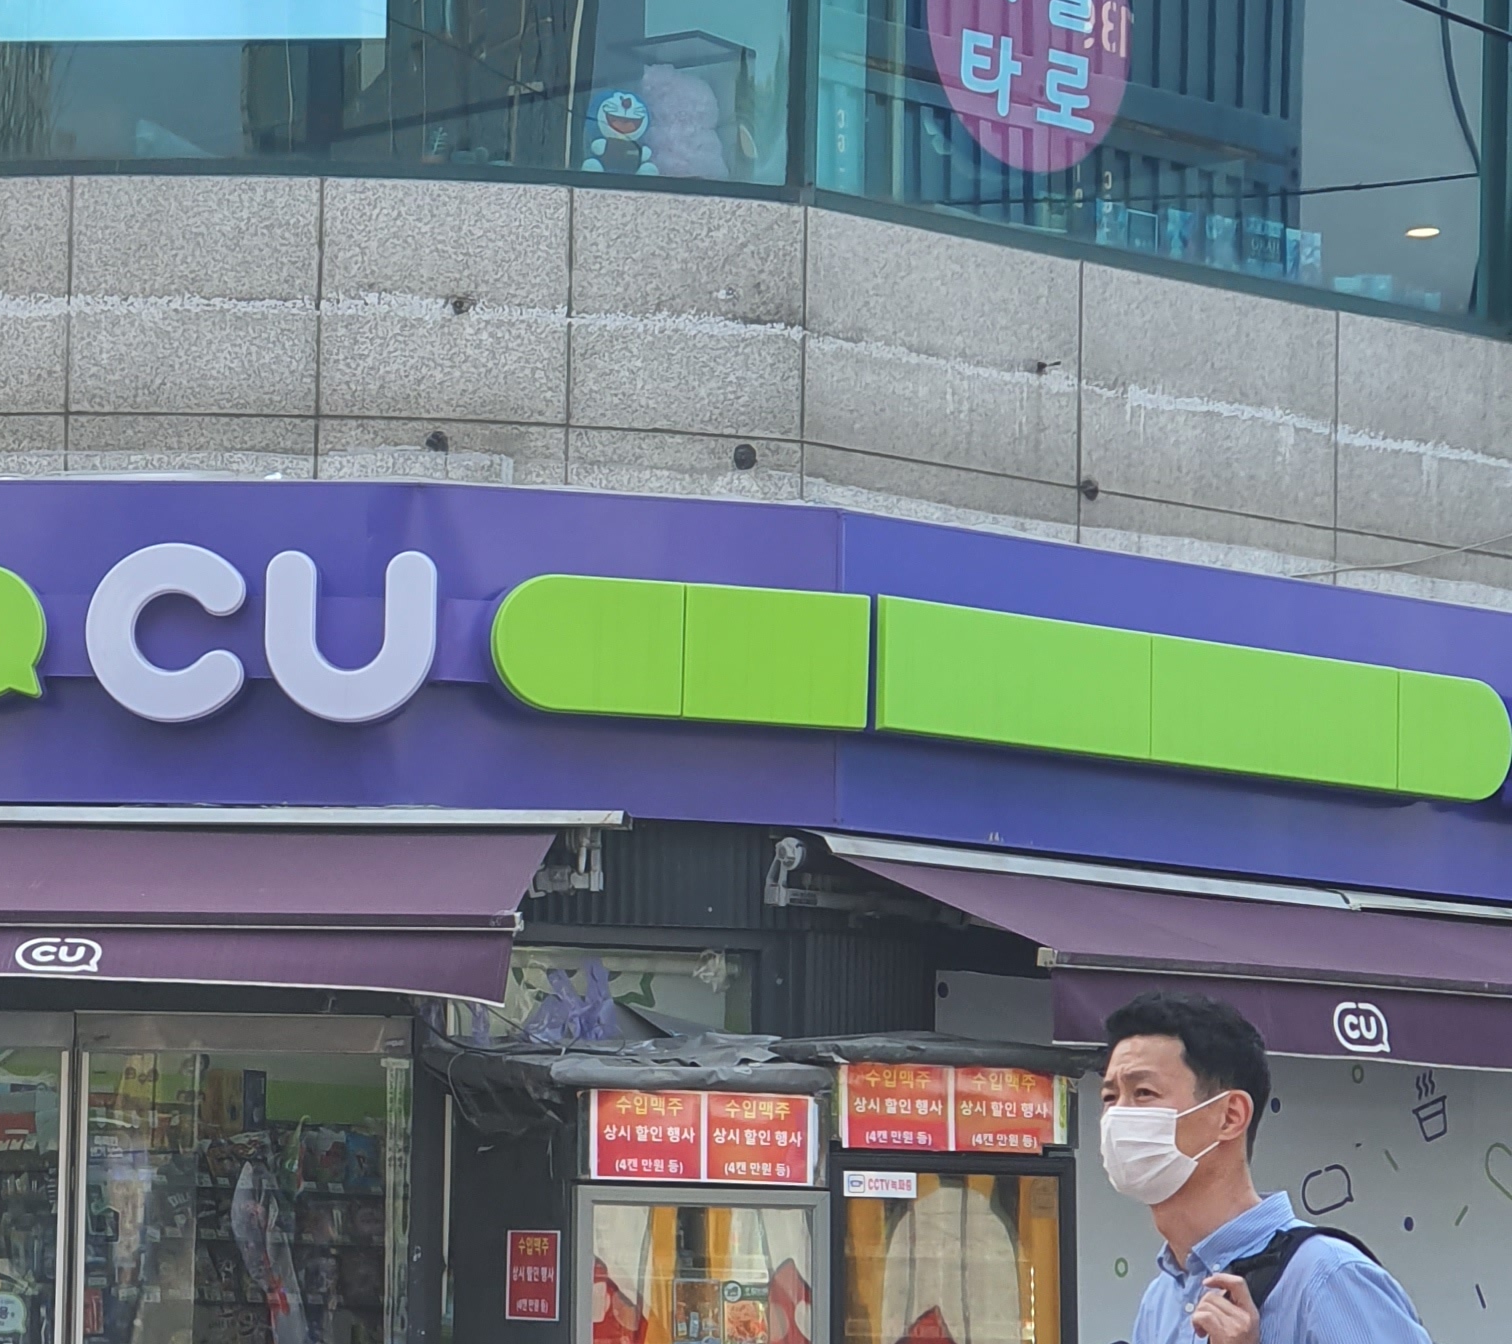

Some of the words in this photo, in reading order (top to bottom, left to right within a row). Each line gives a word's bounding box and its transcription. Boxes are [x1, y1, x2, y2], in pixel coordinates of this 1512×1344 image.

[960, 28, 1095, 135] 타로
[85, 542, 438, 723] CU
[31, 944, 86, 963] CU
[1343, 1013, 1378, 1040] CU
[864, 1068, 931, 1090] 수입맥주
[971, 1072, 1036, 1093] 수입맥주
[615, 1095, 684, 1117] 수입맥주
[724, 1099, 791, 1121] 수입맥주
[854, 1097, 880, 1114] 상시
[885, 1098, 912, 1115] 할인
[915, 1099, 943, 1116] 행사
[960, 1100, 986, 1117] 상시
[991, 1101, 1017, 1118] 할인
[1021, 1102, 1048, 1119] 행사
[603, 1124, 631, 1141] 상시
[635, 1125, 663, 1143] 할인
[667, 1126, 696, 1144] 행사
[712, 1128, 740, 1145] 상시
[744, 1129, 771, 1146] 할인
[775, 1130, 803, 1148] 행사
[890, 1130, 914, 1145] 만원
[916, 1131, 932, 1146] 등)
[997, 1133, 1019, 1148] 만원
[1022, 1134, 1038, 1149] 등)
[641, 1158, 665, 1174] 만원
[667, 1158, 684, 1175] 등)
[749, 1162, 772, 1176] 만원
[775, 1163, 791, 1178] 등)
[518, 1236, 549, 1256] 수입맥주
